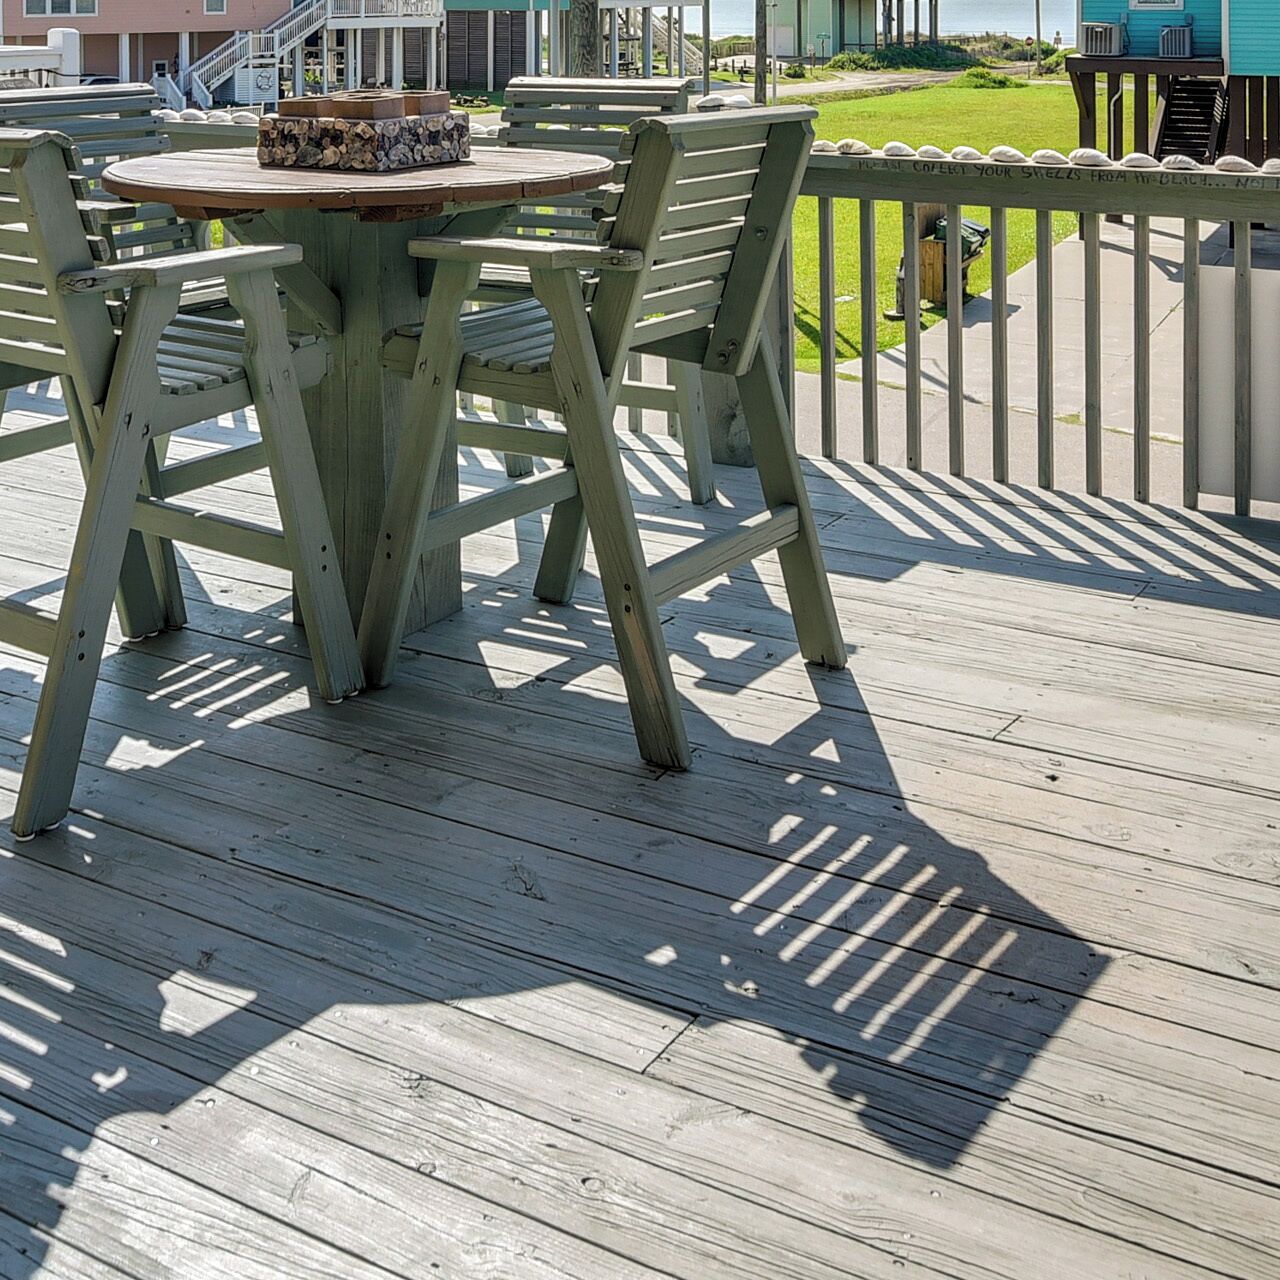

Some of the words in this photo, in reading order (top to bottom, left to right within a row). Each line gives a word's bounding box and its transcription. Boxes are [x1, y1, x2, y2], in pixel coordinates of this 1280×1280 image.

[912, 161, 967, 175] COLLECT
[974, 164, 1013, 178] YOUR
[1020, 167, 1081, 181] SHELLS
[1091, 171, 1128, 183] FROM
